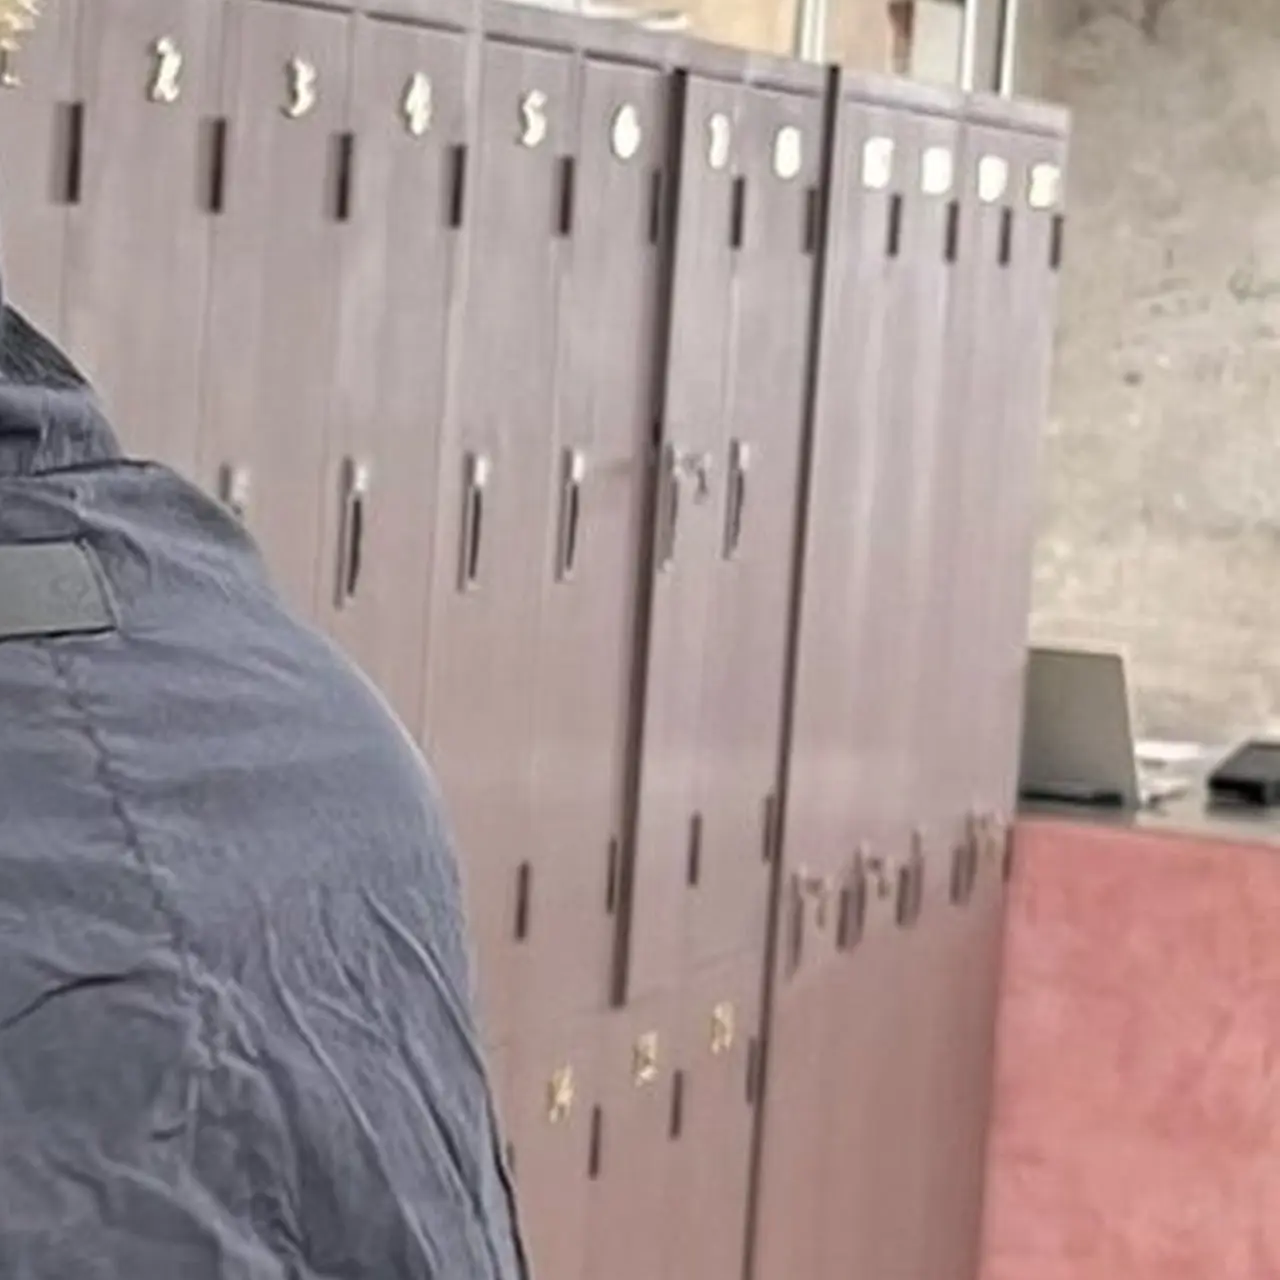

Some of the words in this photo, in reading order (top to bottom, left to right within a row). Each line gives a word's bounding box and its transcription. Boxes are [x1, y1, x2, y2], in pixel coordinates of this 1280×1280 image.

[149, 36, 181, 102] 2
[284, 57, 316, 118] 3
[522, 87, 546, 147] 5
